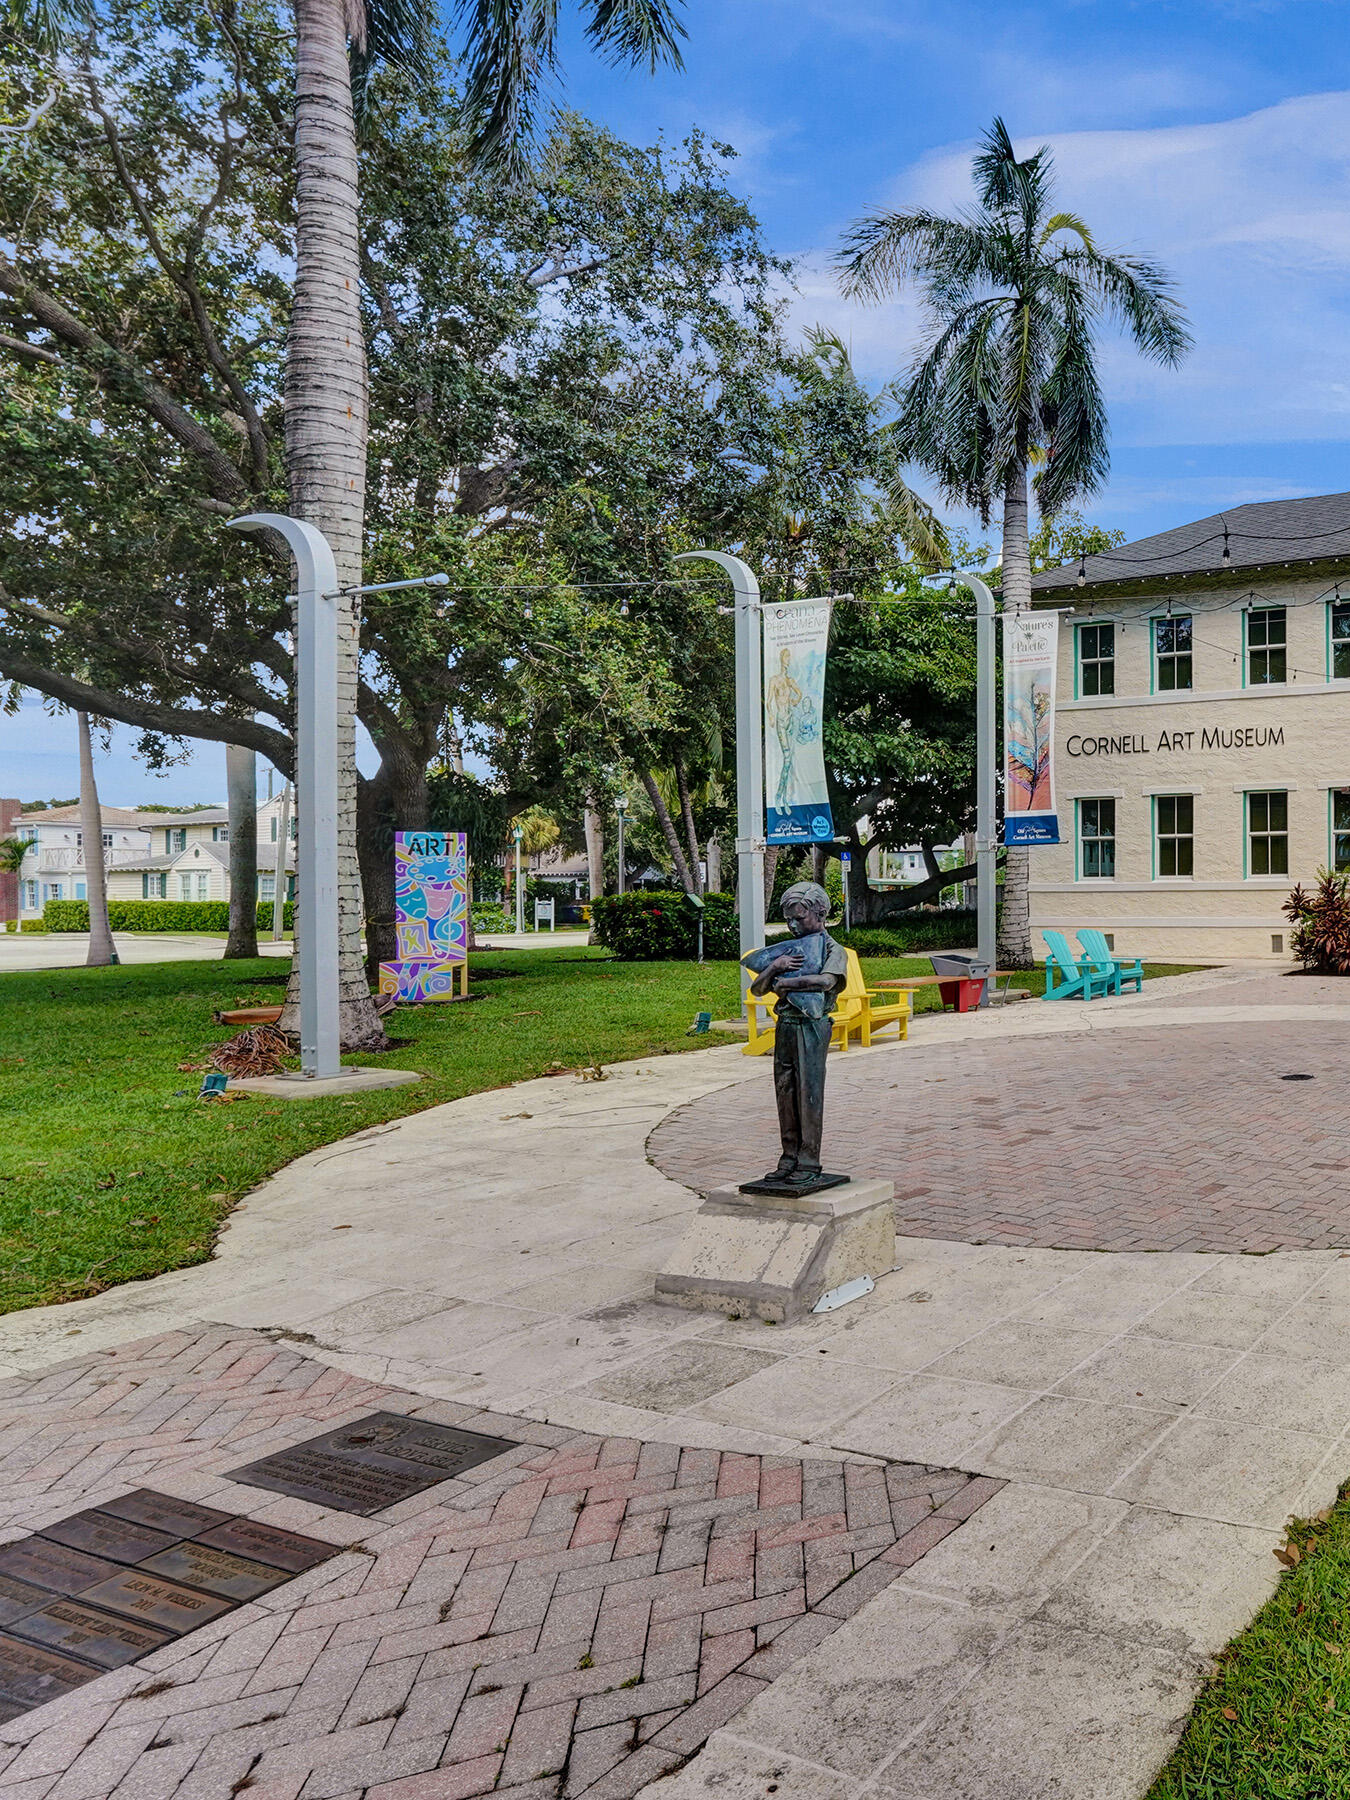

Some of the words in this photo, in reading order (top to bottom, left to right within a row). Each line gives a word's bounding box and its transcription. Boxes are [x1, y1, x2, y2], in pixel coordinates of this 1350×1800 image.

[1006, 619, 1054, 635] Nature's
[1157, 730, 1195, 752] ART
[1201, 727, 1285, 749] MUSEUM
[408, 838, 454, 856] ART
[415, 1436, 475, 1455] SERVICE
[122, 1580, 156, 1593] LEON
[130, 1598, 157, 1611] 2001
